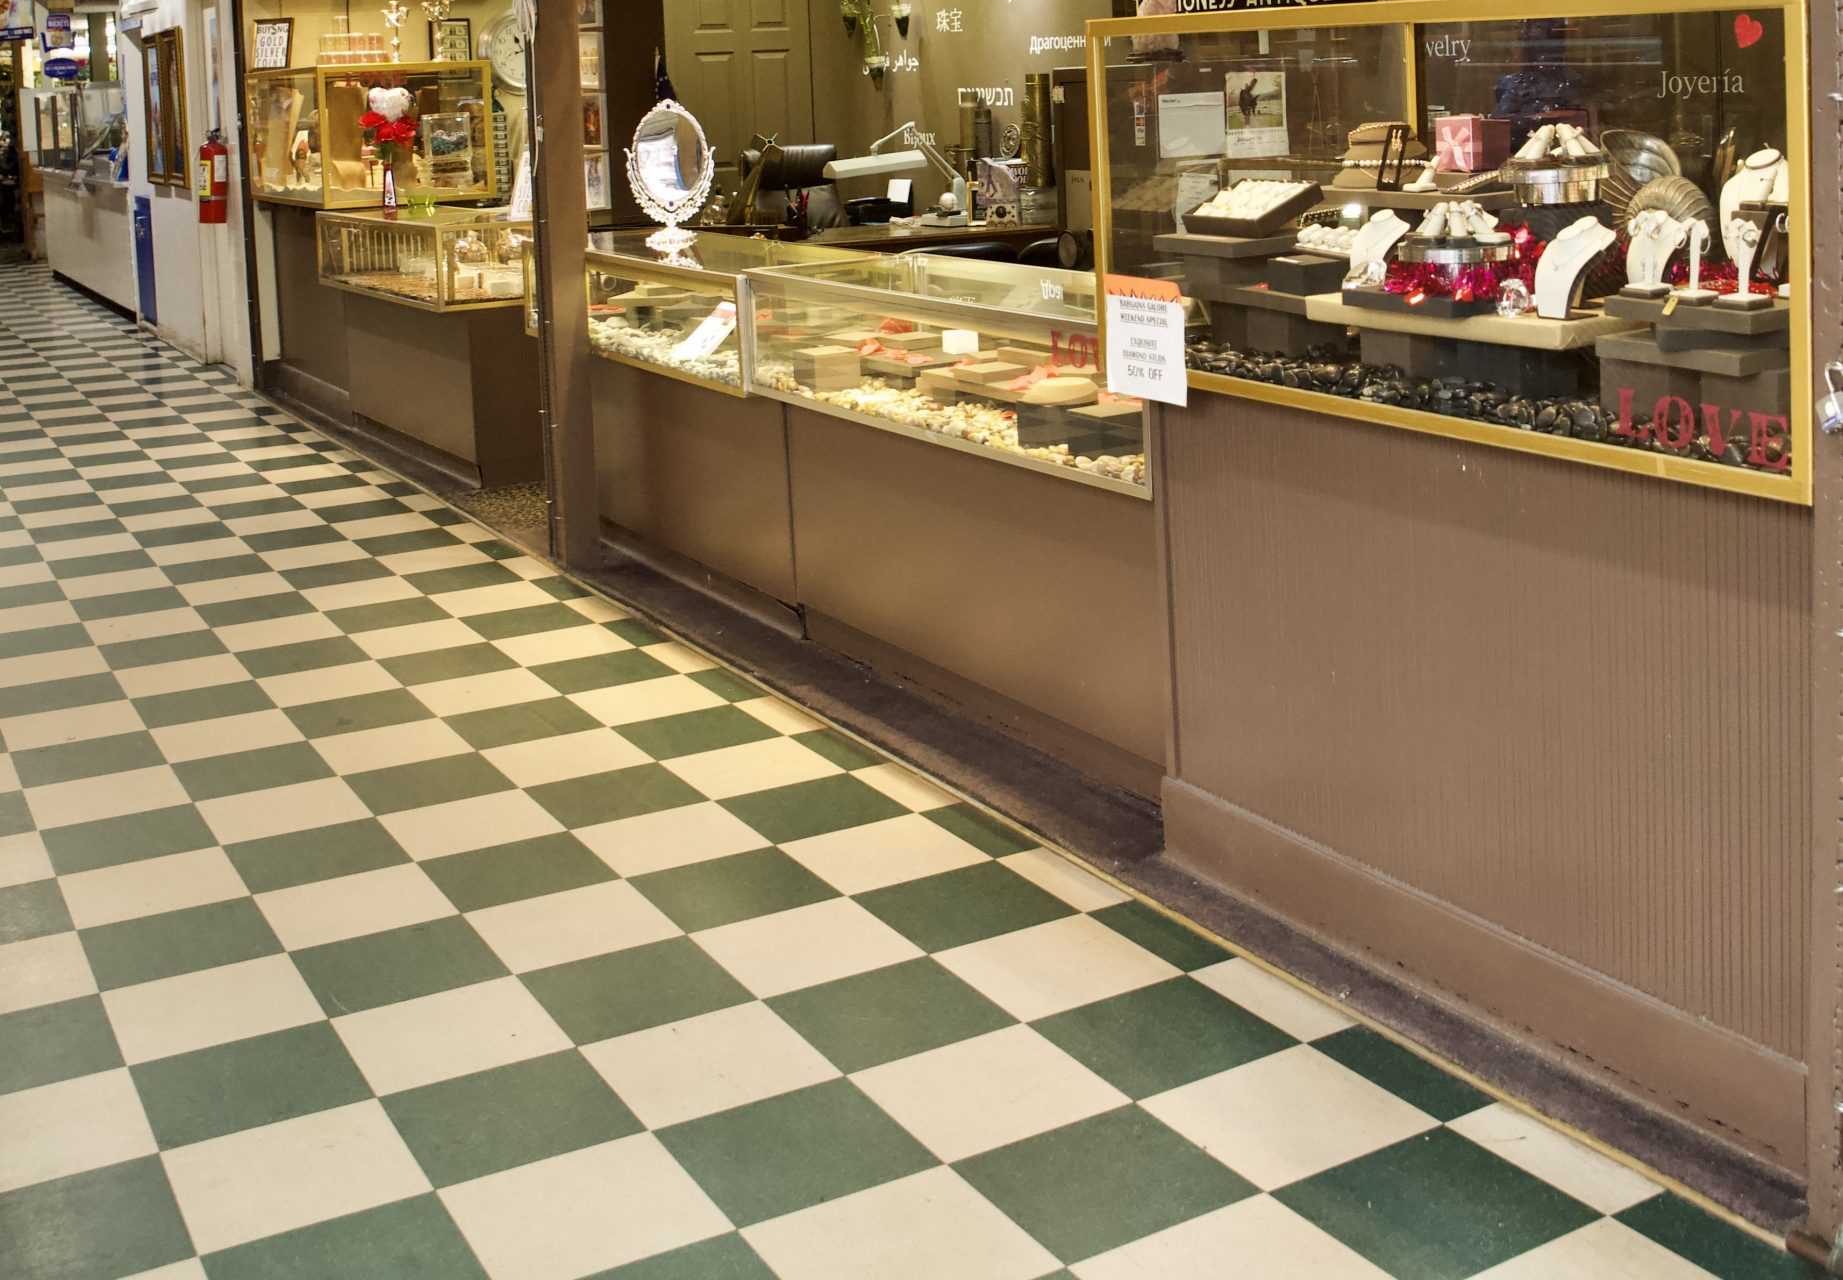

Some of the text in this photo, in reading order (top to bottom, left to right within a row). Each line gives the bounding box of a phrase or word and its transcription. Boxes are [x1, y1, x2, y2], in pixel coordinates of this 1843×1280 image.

[936, 8, 963, 33] 珠宝
[260, 36, 284, 47] GOLD
[256, 47, 286, 58] SILVER
[1657, 69, 1744, 99] Joyería
[1120, 313, 1169, 326] WEEKEND SPECIAL
[1122, 349, 1147, 359] DIAMOND
[1127, 364, 1163, 380] 50% OFF
[1616, 387, 1790, 470] LOVE
